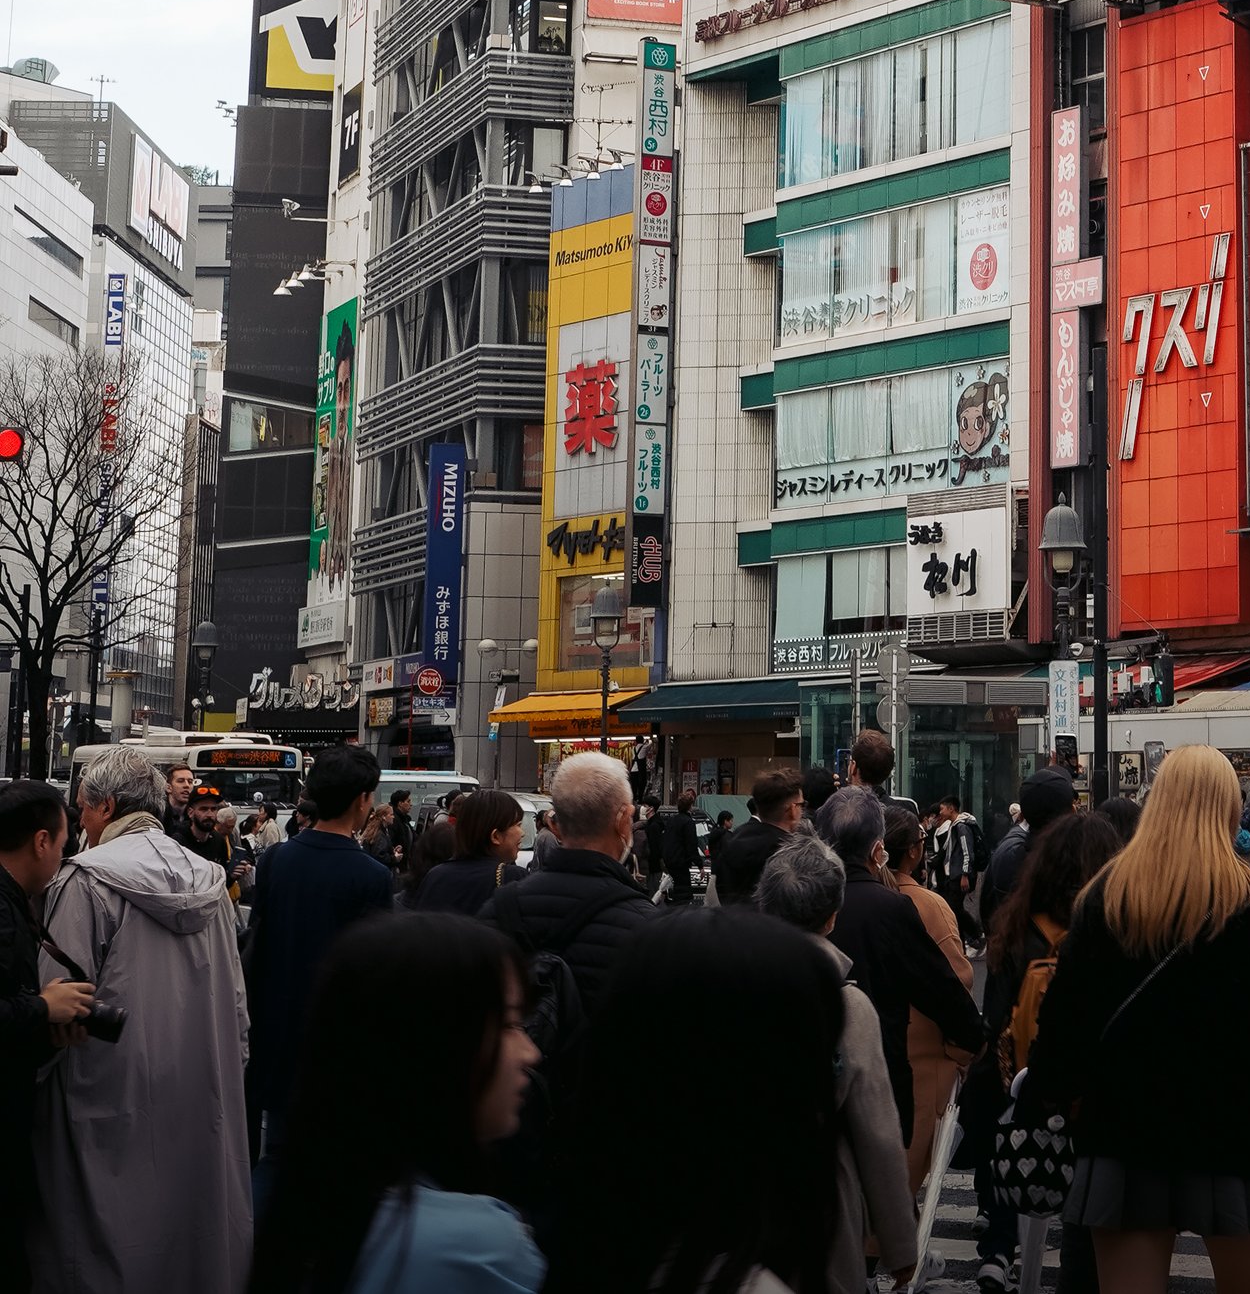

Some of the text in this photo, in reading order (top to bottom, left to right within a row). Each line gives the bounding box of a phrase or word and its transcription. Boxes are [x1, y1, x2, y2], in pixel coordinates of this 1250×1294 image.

[648, 73, 669, 137] 渋谷西村
[345, 109, 359, 151] 7F
[643, 182, 671, 192] クリニック
[650, 158, 665, 170] 4F
[1056, 116, 1077, 254] お好み焼
[147, 216, 184, 272] SHIBUYA
[554, 231, 634, 267] Matsumoto KiY
[106, 296, 123, 344] LABI
[959, 290, 1008, 310] 渋谷クリニック
[640, 358, 651, 402] パーラー
[652, 353, 664, 397] フルーツ
[1056, 317, 1076, 462] もんじゃ焼
[564, 359, 620, 456] 薬
[637, 448, 648, 493] フルーツ
[650, 443, 662, 490] 渋谷西村
[777, 458, 949, 499] ジャスミンレディースクリニック
[442, 463, 458, 532] MIZUHO
[908, 521, 943, 545] うなぎ
[637, 535, 662, 583] HUB
[922, 547, 977, 599] 松川
[433, 586, 450, 661] みずほ銀行
[777, 639, 883, 663] 渋谷西村 フルツパ
[1054, 668, 1067, 733] 文化村通
